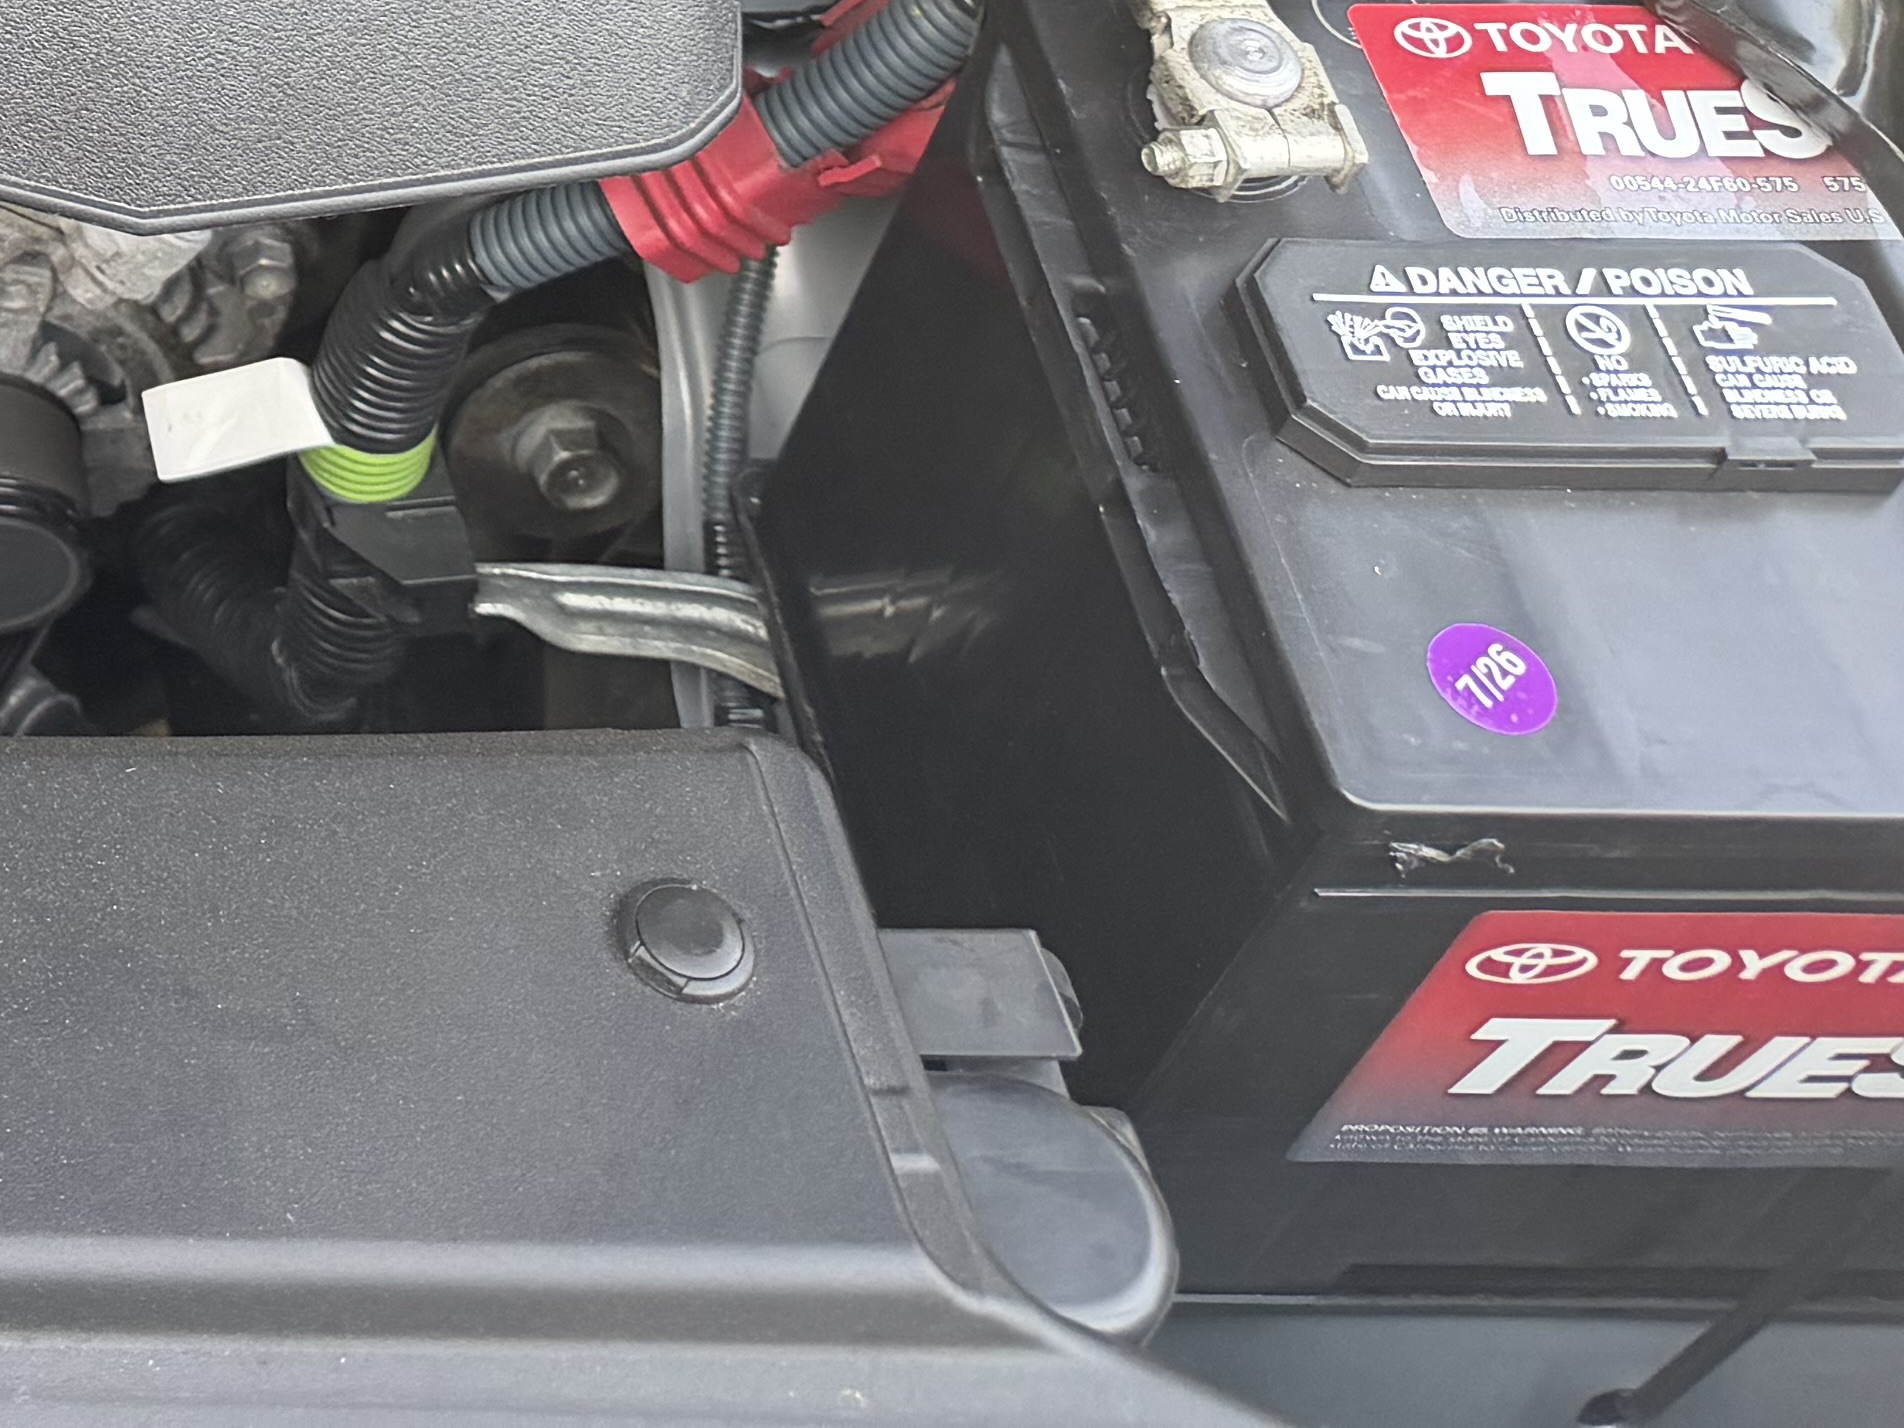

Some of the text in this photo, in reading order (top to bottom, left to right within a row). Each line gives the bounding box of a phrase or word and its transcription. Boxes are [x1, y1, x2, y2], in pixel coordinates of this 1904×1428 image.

[1474, 22, 1695, 55] TOYOTA
[1609, 175, 1799, 194] 00544-24F60-575
[1500, 206, 1614, 224] Distributed
[1619, 207, 1644, 228] by
[1644, 207, 1717, 227] Toyota
[1721, 208, 1783, 225] Motor
[1787, 208, 1844, 225] Sales
[1404, 266, 1754, 295] DANGER / POISON
[1441, 315, 1514, 332] SHIELD
[1447, 332, 1506, 350] EYES
[1408, 349, 1525, 368] EXPLOSIVE
[1594, 355, 1629, 371] NO
[1705, 356, 1858, 374] SULFURIC ACID
[1418, 367, 1490, 385] GASES
[1714, 373, 1752, 389] CAN
[1596, 387, 1663, 403] FLAMES
[1455, 643, 1527, 709] 7/26
